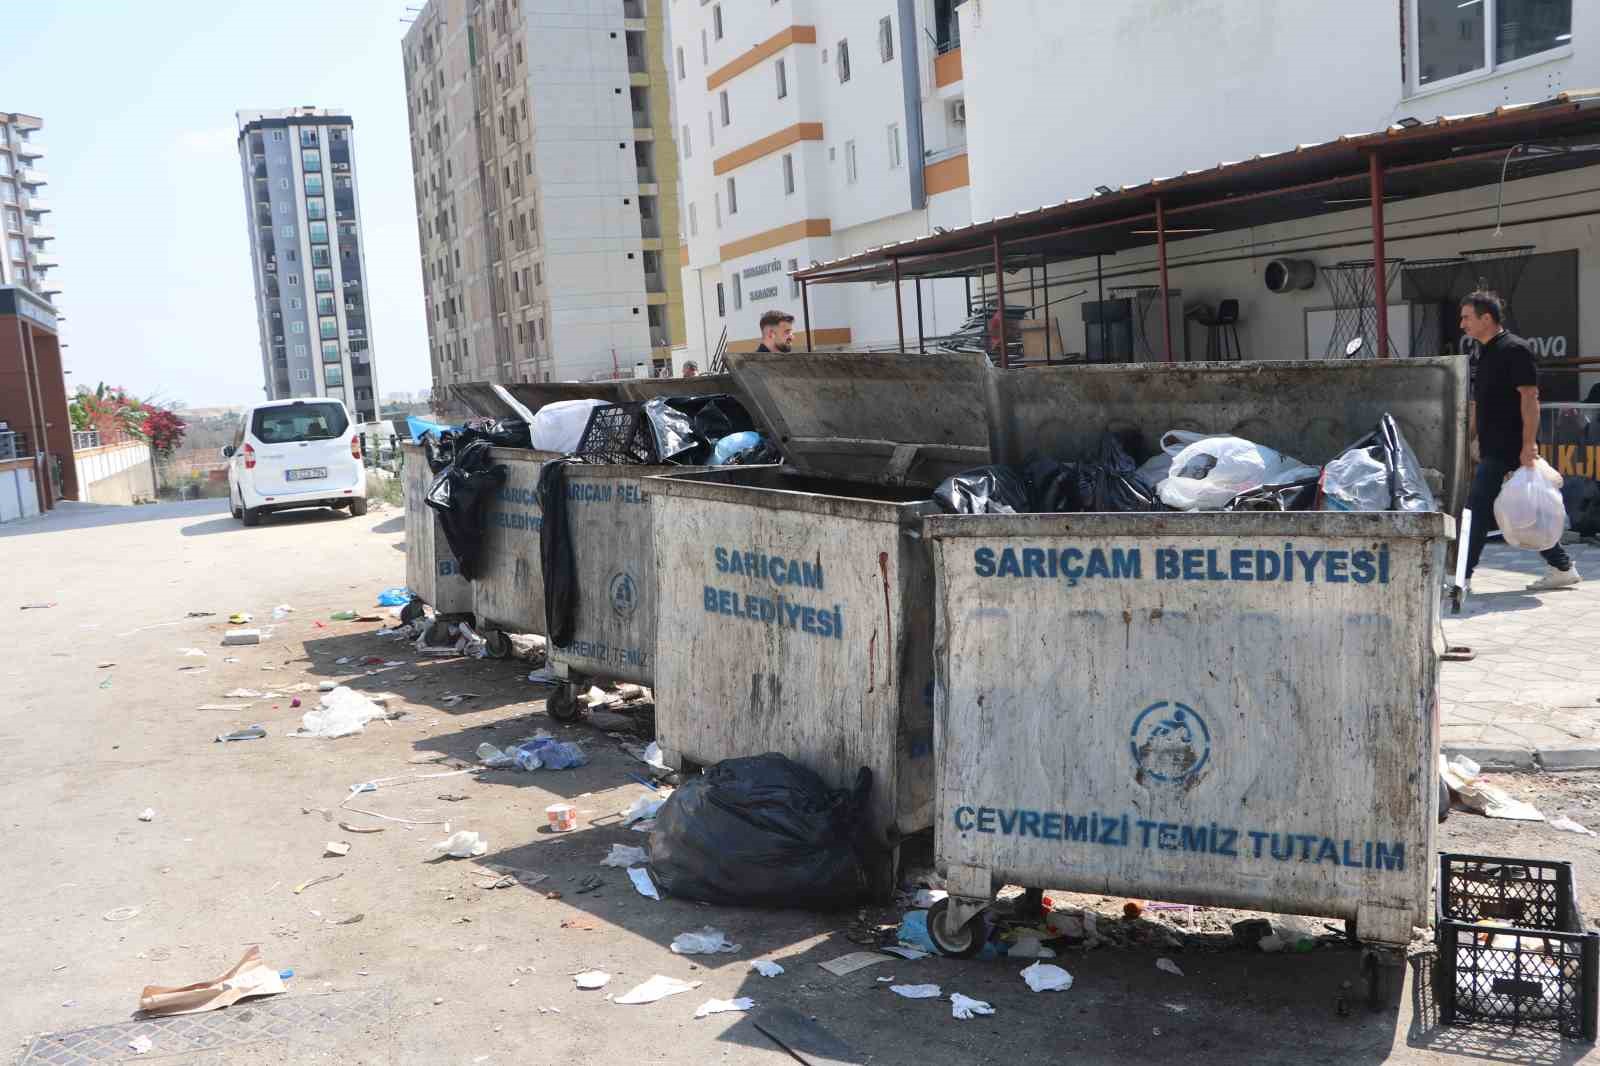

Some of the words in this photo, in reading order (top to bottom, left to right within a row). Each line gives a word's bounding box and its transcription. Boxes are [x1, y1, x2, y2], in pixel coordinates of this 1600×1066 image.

[974, 546, 1141, 587] SARIÇAM
[1155, 542, 1390, 584] BELEDİYESİ
[703, 585, 843, 640] BELEDİYESİ
[953, 804, 1129, 847] ÇEVREMİZİ
[1136, 818, 1239, 857] TEMİZ
[1247, 830, 1407, 872] TUTALIM
